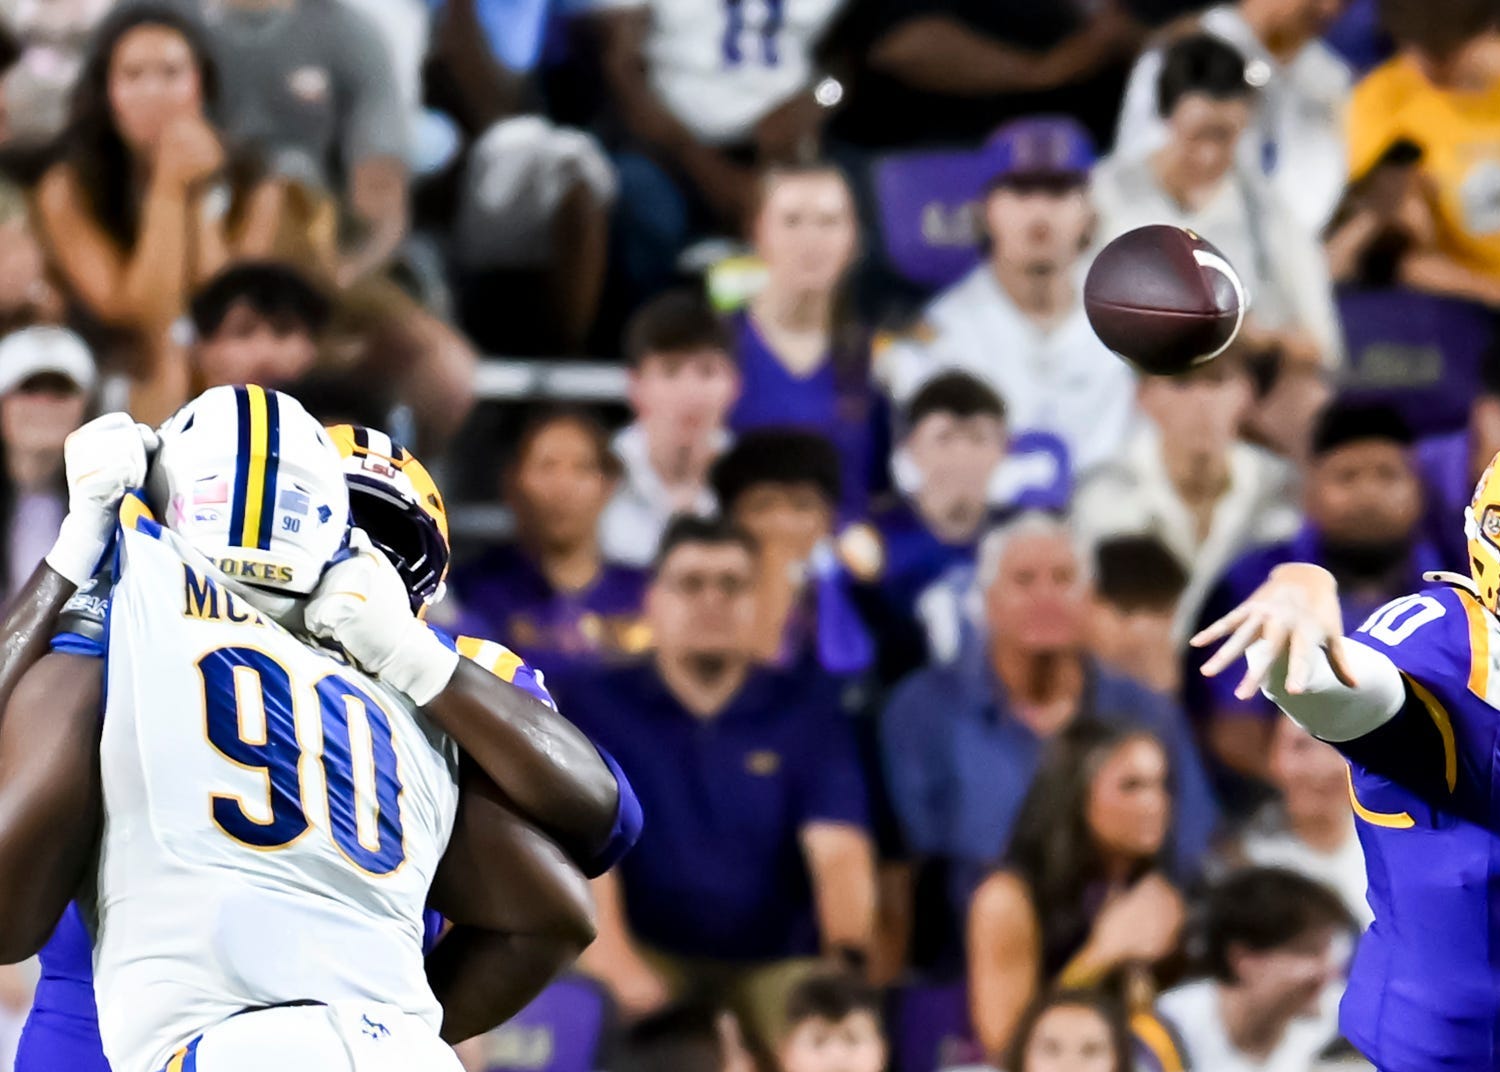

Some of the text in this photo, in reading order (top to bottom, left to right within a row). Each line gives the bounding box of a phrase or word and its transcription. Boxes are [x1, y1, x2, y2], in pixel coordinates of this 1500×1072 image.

[361, 459, 396, 479] LSU
[282, 515, 301, 533] 90
[207, 557, 294, 584] OKES
[194, 644, 407, 877] 90
